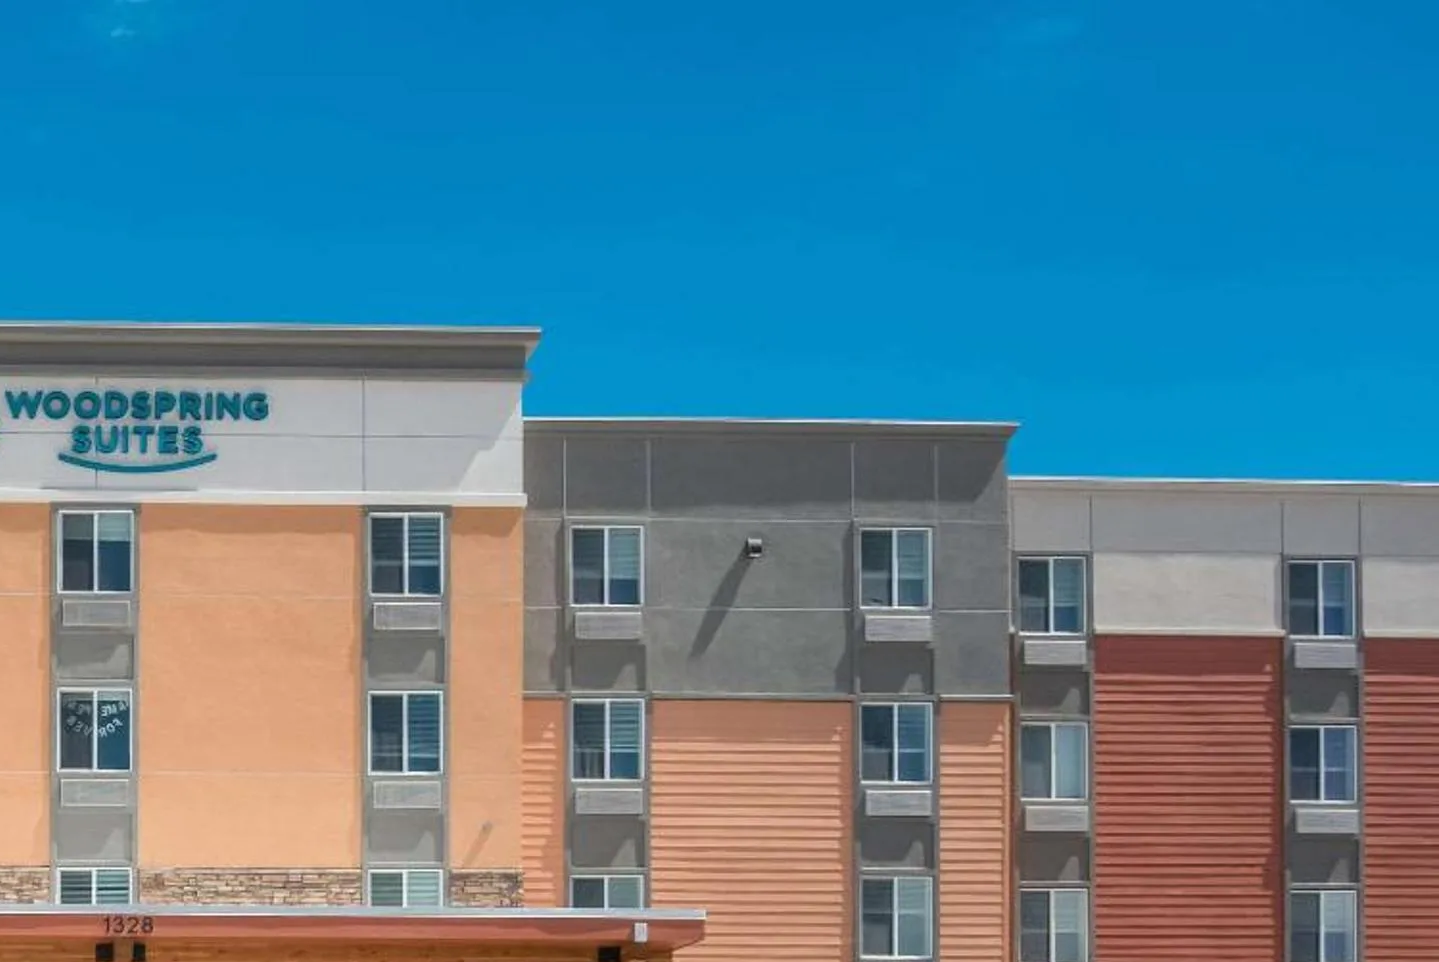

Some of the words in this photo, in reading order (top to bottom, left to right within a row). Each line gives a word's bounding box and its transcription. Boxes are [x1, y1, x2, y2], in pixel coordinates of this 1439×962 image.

[5, 390, 270, 421] WOODSPRING
[71, 425, 205, 454] SUITES
[103, 916, 154, 933] 1328
